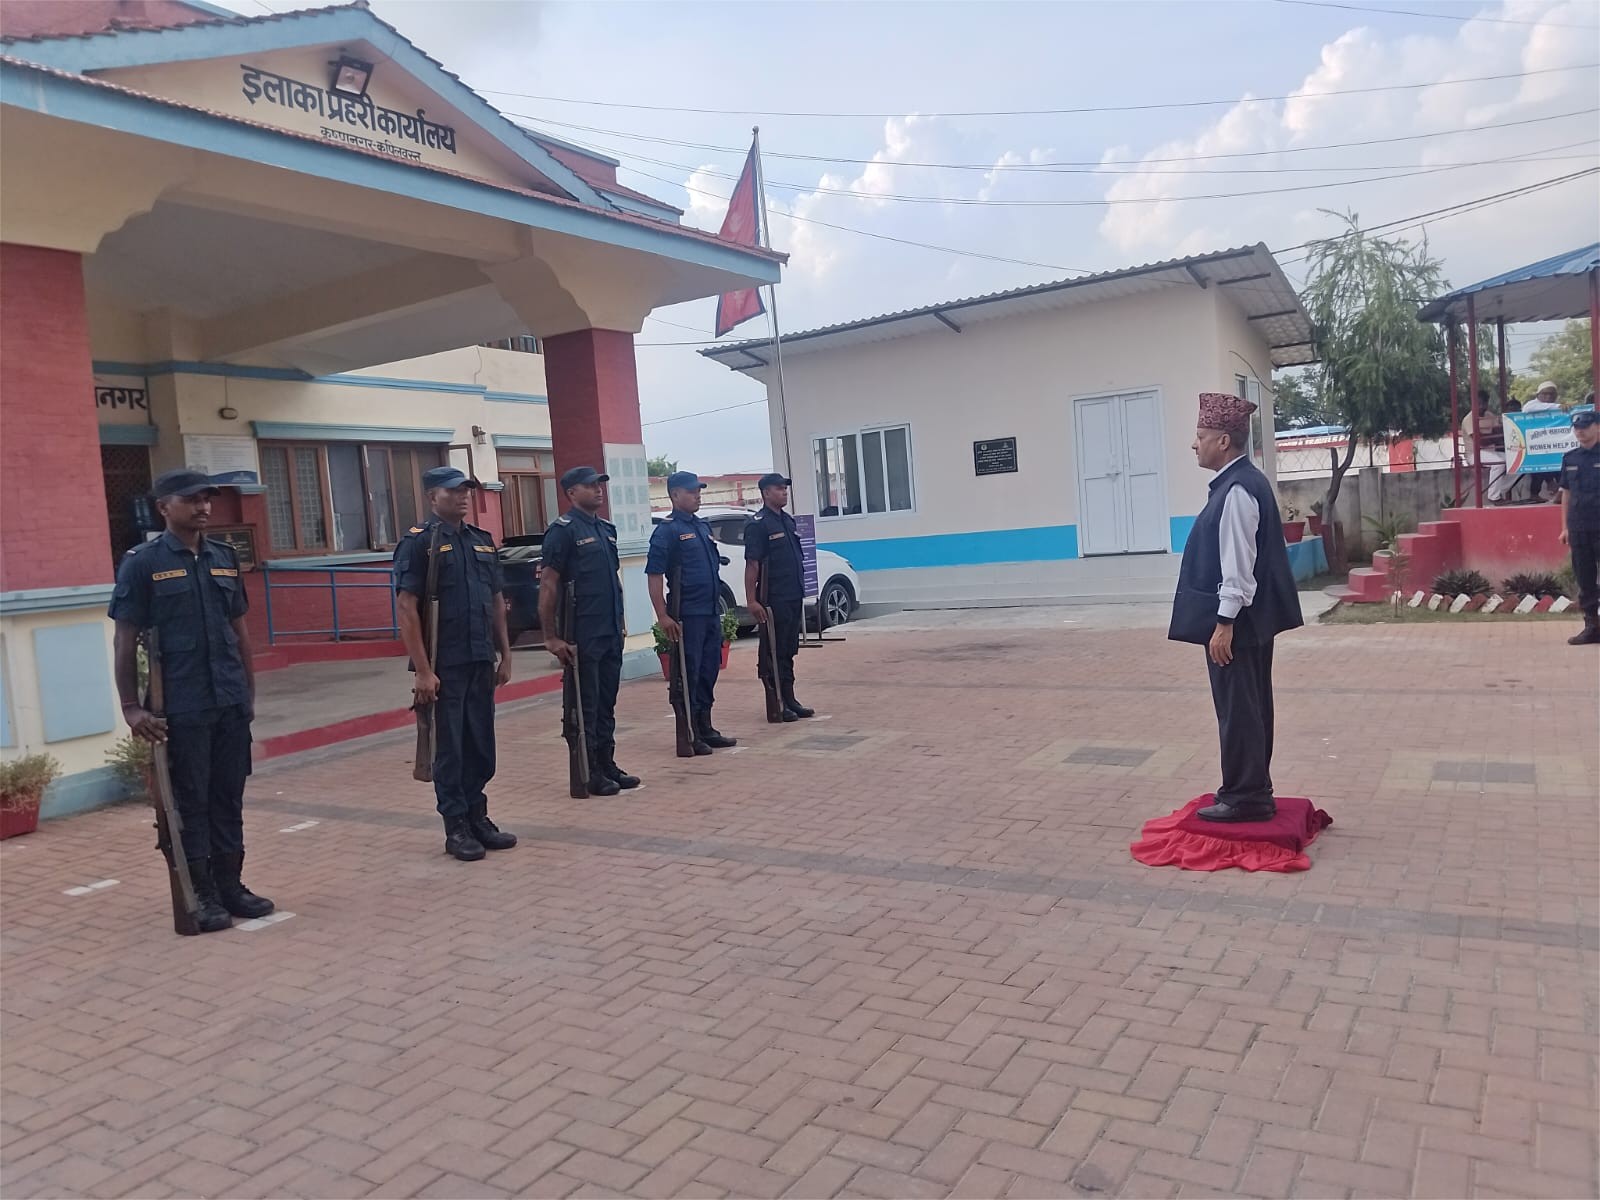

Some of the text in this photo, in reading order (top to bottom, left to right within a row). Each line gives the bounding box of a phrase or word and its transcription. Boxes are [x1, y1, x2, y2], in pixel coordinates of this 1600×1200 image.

[240, 64, 457, 154] इलाका प्रहरी कार्यालय
[1530, 443, 1552, 451] WOMEN
[1552, 441, 1569, 449] HELP
